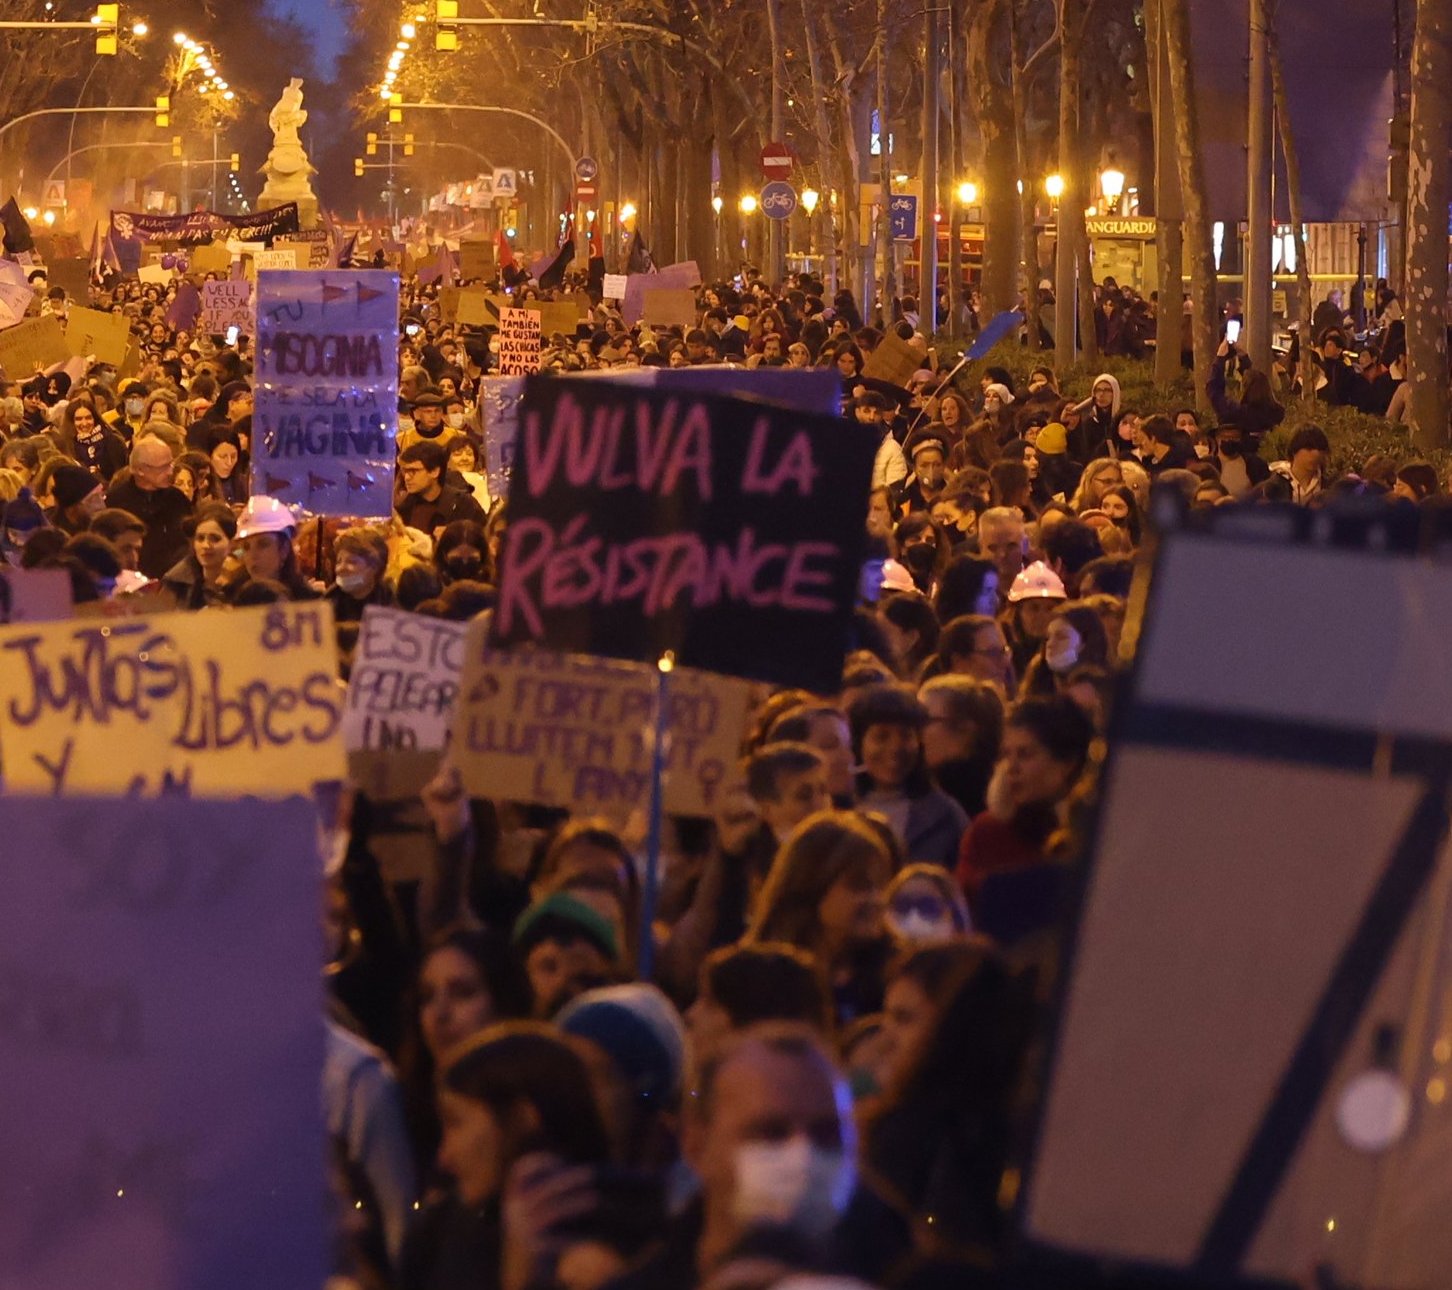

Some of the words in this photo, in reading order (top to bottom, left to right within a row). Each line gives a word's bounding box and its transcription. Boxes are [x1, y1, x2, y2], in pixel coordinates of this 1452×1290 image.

[1086, 221, 1156, 235] ANGUARDIA
[208, 286, 239, 296] WELL
[210, 310, 224, 320] IF
[268, 300, 303, 322] TU
[508, 310, 515, 318] A
[502, 316, 540, 330] TAMBIÉN
[501, 331, 512, 339] ME
[513, 330, 541, 340] GUSTAN
[500, 342, 514, 351] LAS
[515, 342, 540, 352] CHICAS
[502, 354, 507, 362] Y
[509, 354, 522, 362] NO
[525, 354, 540, 363] LAS
[261, 413, 387, 458] VAGINA
[523, 392, 715, 500] VULVA
[741, 417, 821, 497] LA
[499, 514, 843, 638] RÉSISTANCE
[261, 609, 322, 651] 8M
